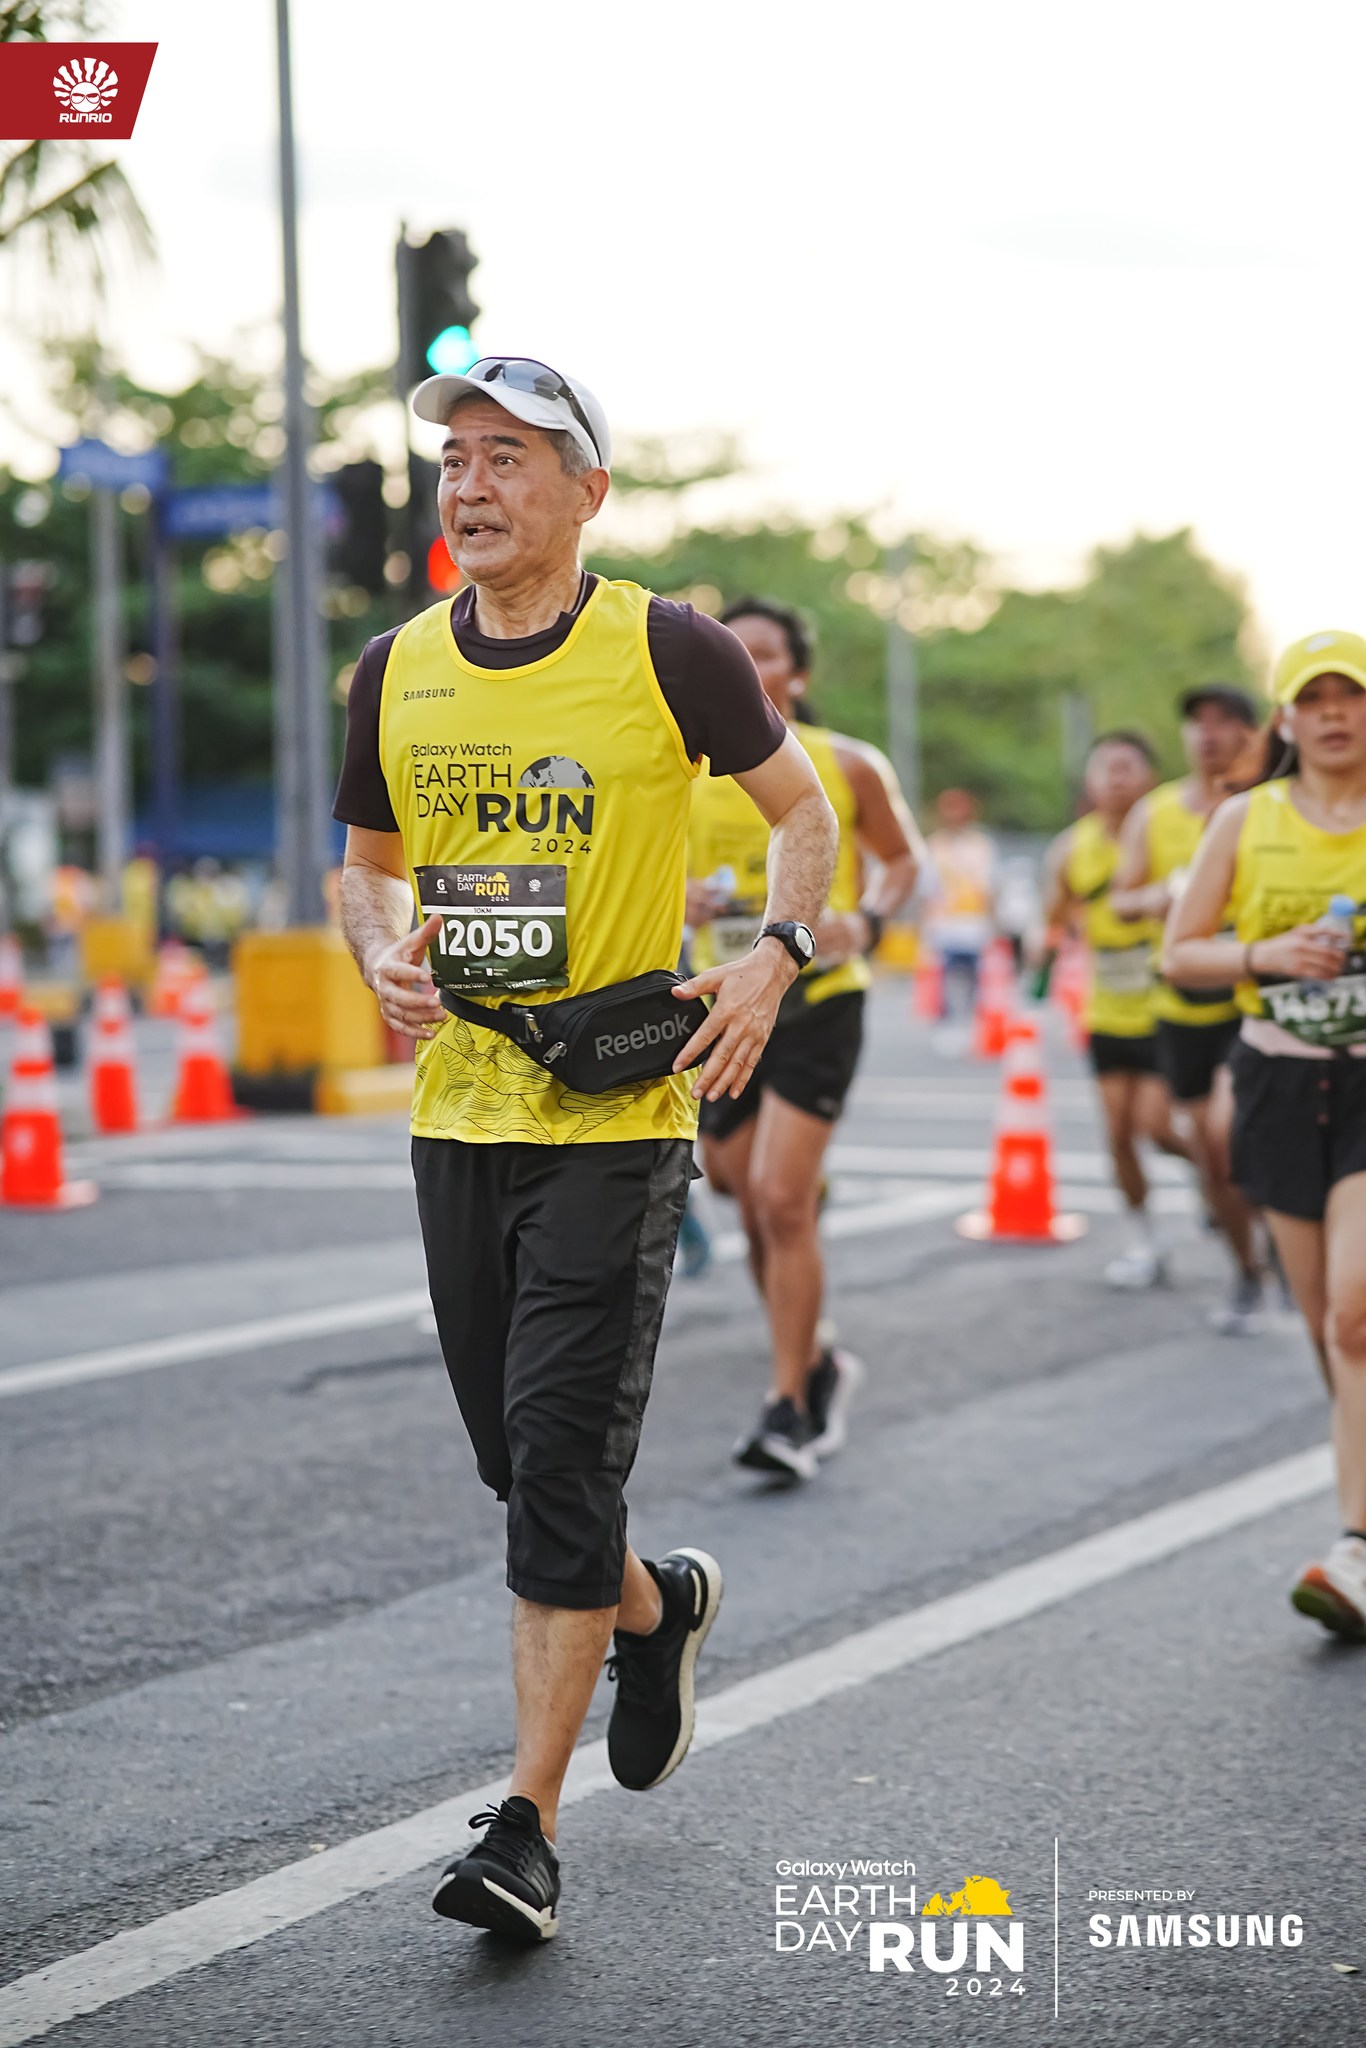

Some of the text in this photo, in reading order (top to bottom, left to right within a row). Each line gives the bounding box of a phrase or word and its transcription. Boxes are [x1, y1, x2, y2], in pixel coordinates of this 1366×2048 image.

[403, 688, 456, 701] SAMSUNG
[411, 743, 512, 759] Galaxy Watch
[414, 763, 511, 789] EARTH
[417, 792, 595, 835] DAY RUN
[530, 837, 592, 854] 2024
[457, 873, 487, 882] EARTH
[457, 882, 510, 896] DAY RUN
[438, 919, 553, 958] 12050
[594, 1013, 692, 1061] Reebok
